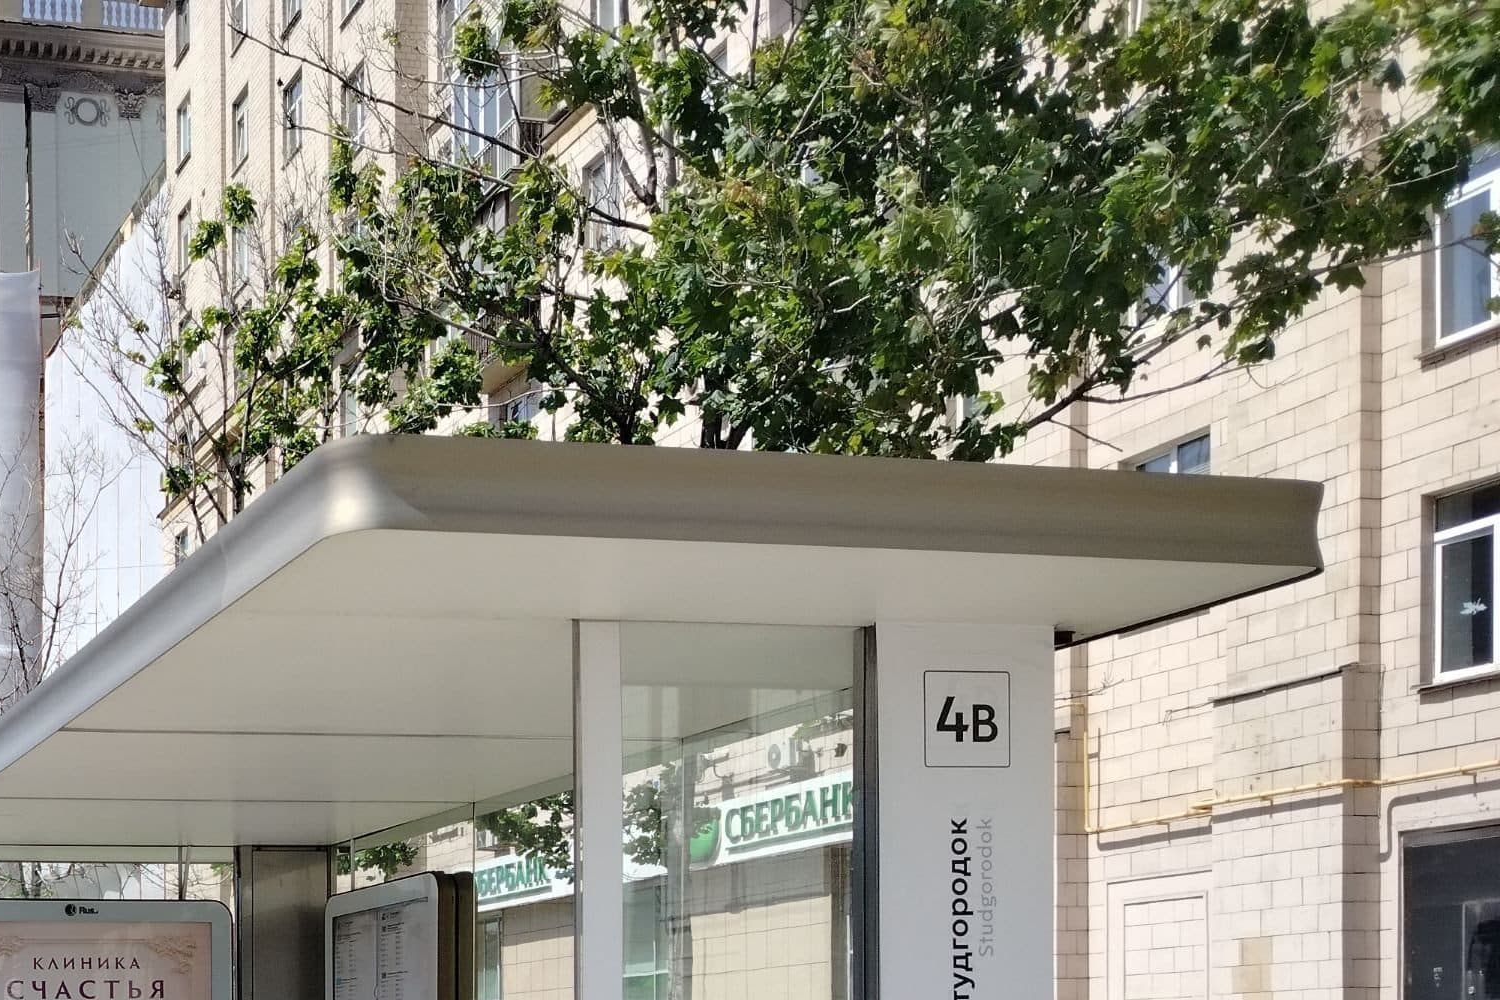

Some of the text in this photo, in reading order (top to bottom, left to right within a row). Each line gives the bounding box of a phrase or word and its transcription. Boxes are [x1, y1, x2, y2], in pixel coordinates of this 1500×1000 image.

[977, 817, 997, 957] Studgorodok
[33, 957, 141, 970] КЛИНИКА
[6, 979, 165, 1000] СЧАСТЬЯ
